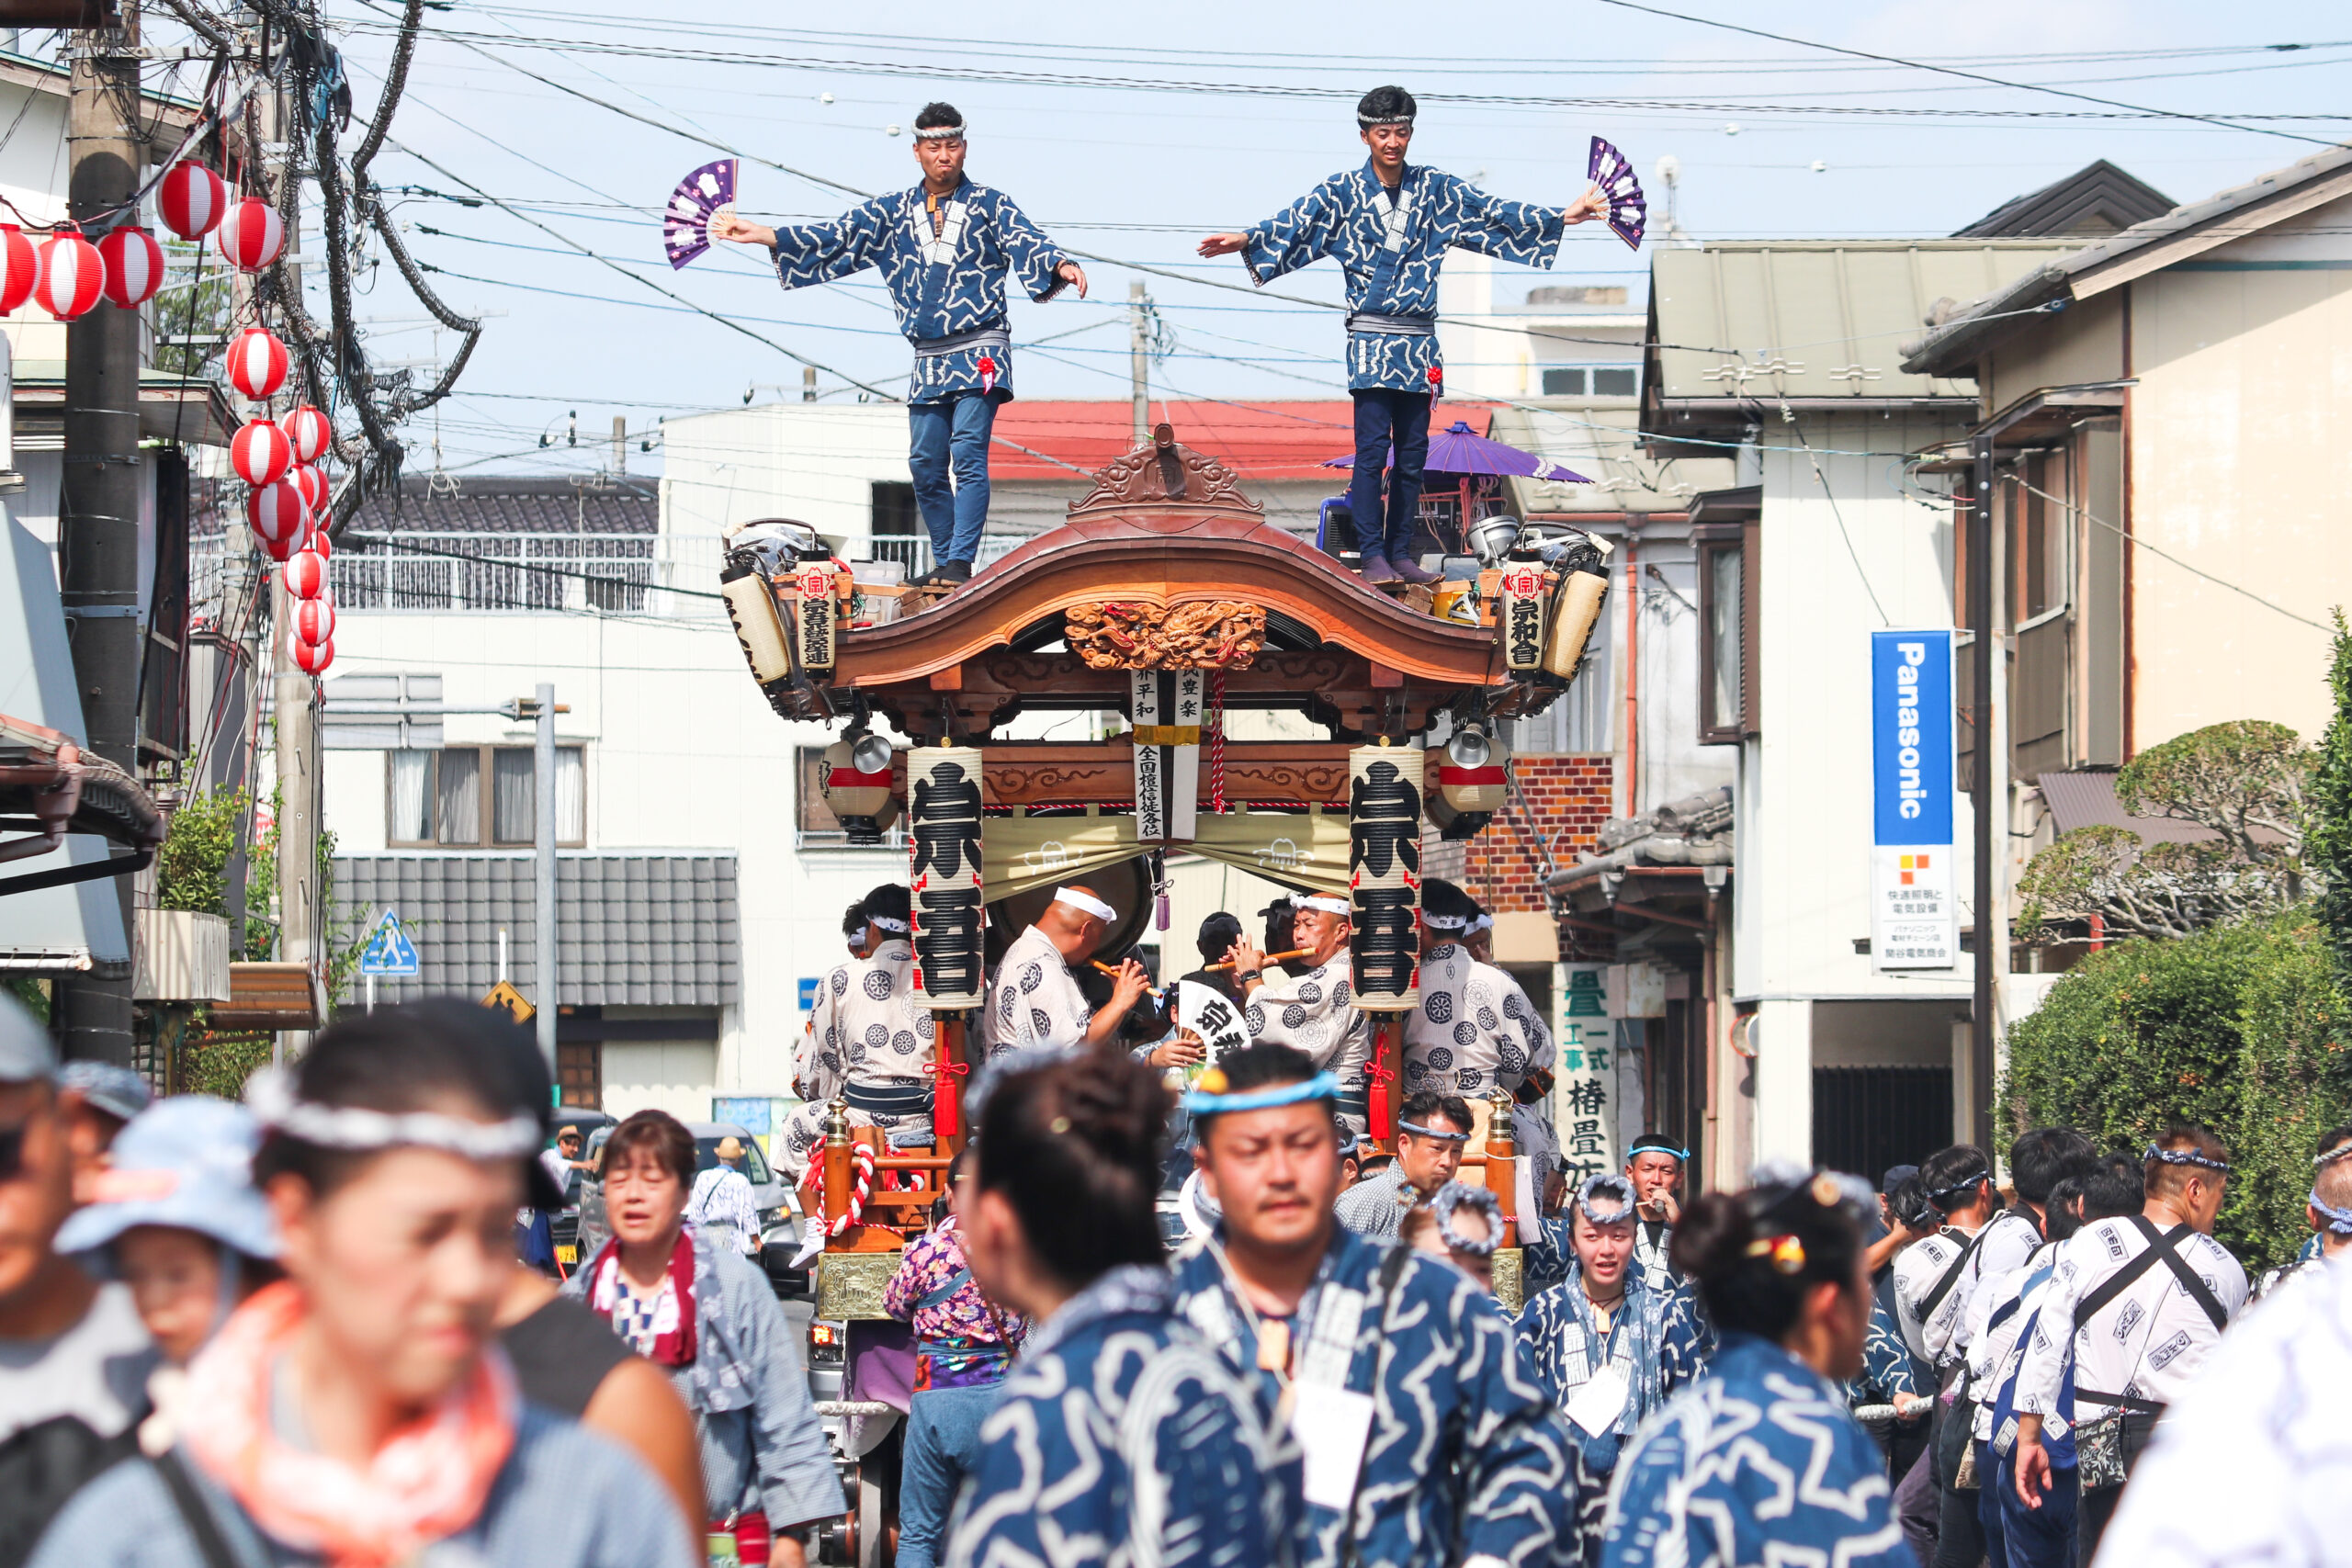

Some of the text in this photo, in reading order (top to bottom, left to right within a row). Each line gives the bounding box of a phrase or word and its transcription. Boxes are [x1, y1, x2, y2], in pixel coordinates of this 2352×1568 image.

[1138, 745, 1162, 837] 全国檀信徒各位
[1896, 642, 1927, 819] Panasonic
[912, 761, 983, 998] 宗吾
[1350, 761, 1421, 998] 宗吾
[1893, 903, 1938, 915] 電気設備
[1564, 971, 1608, 1017] 畳
